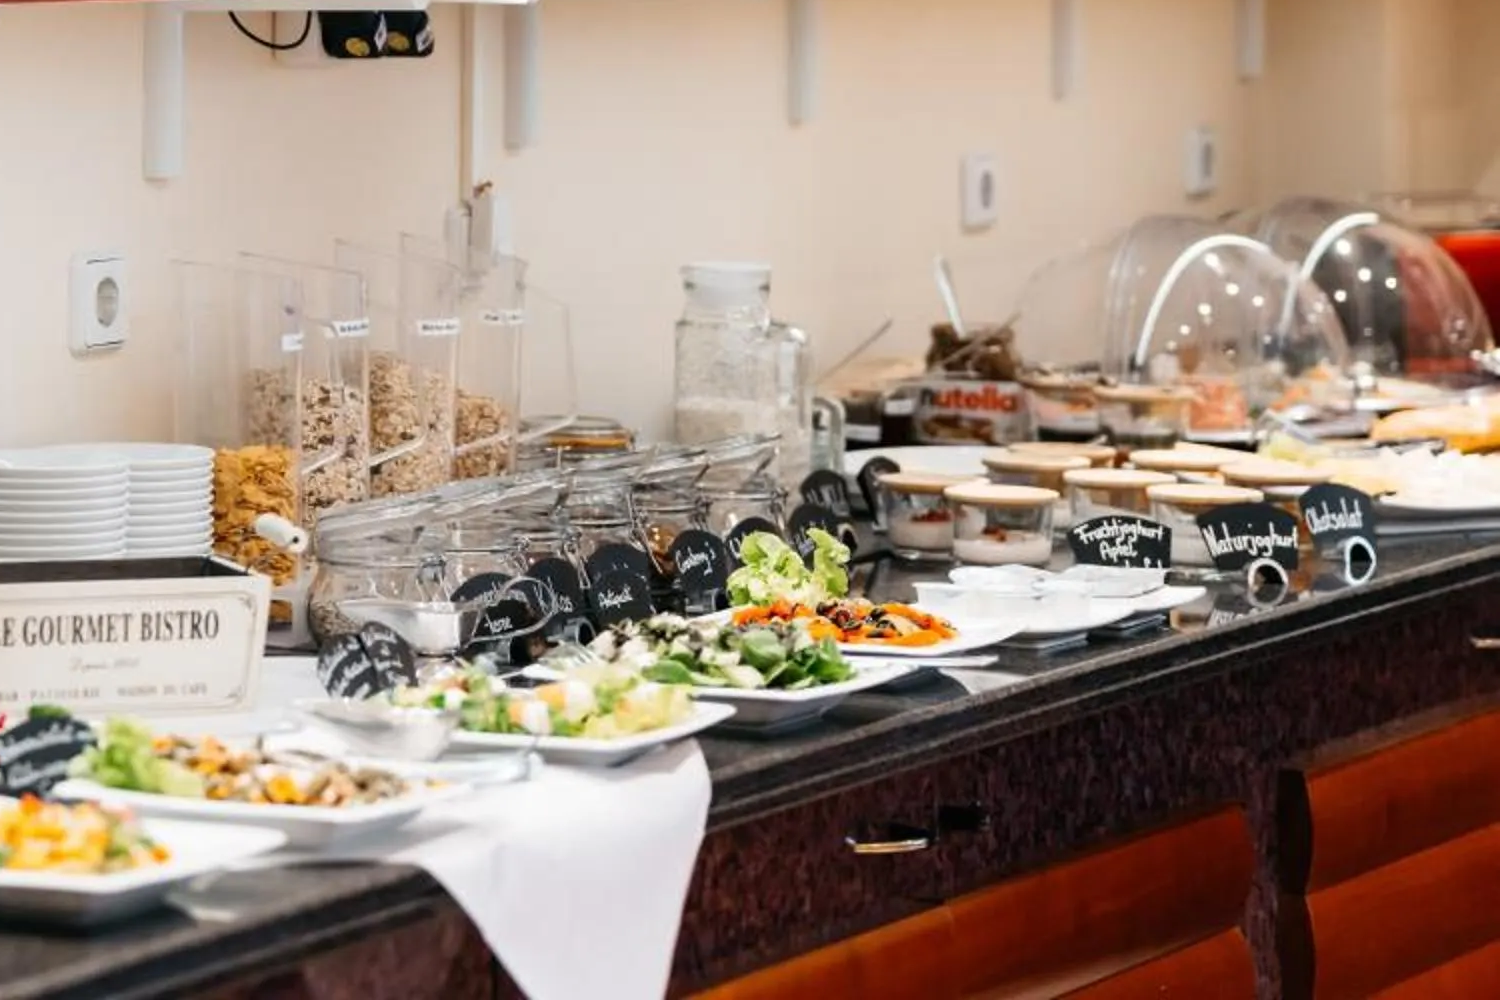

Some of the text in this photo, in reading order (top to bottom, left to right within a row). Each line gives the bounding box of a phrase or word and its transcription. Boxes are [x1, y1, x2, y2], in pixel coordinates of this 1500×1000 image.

[1203, 521, 1298, 556] Naturjoghurt
[22, 612, 134, 646] GOURMET
[140, 609, 220, 642] BISTRO
